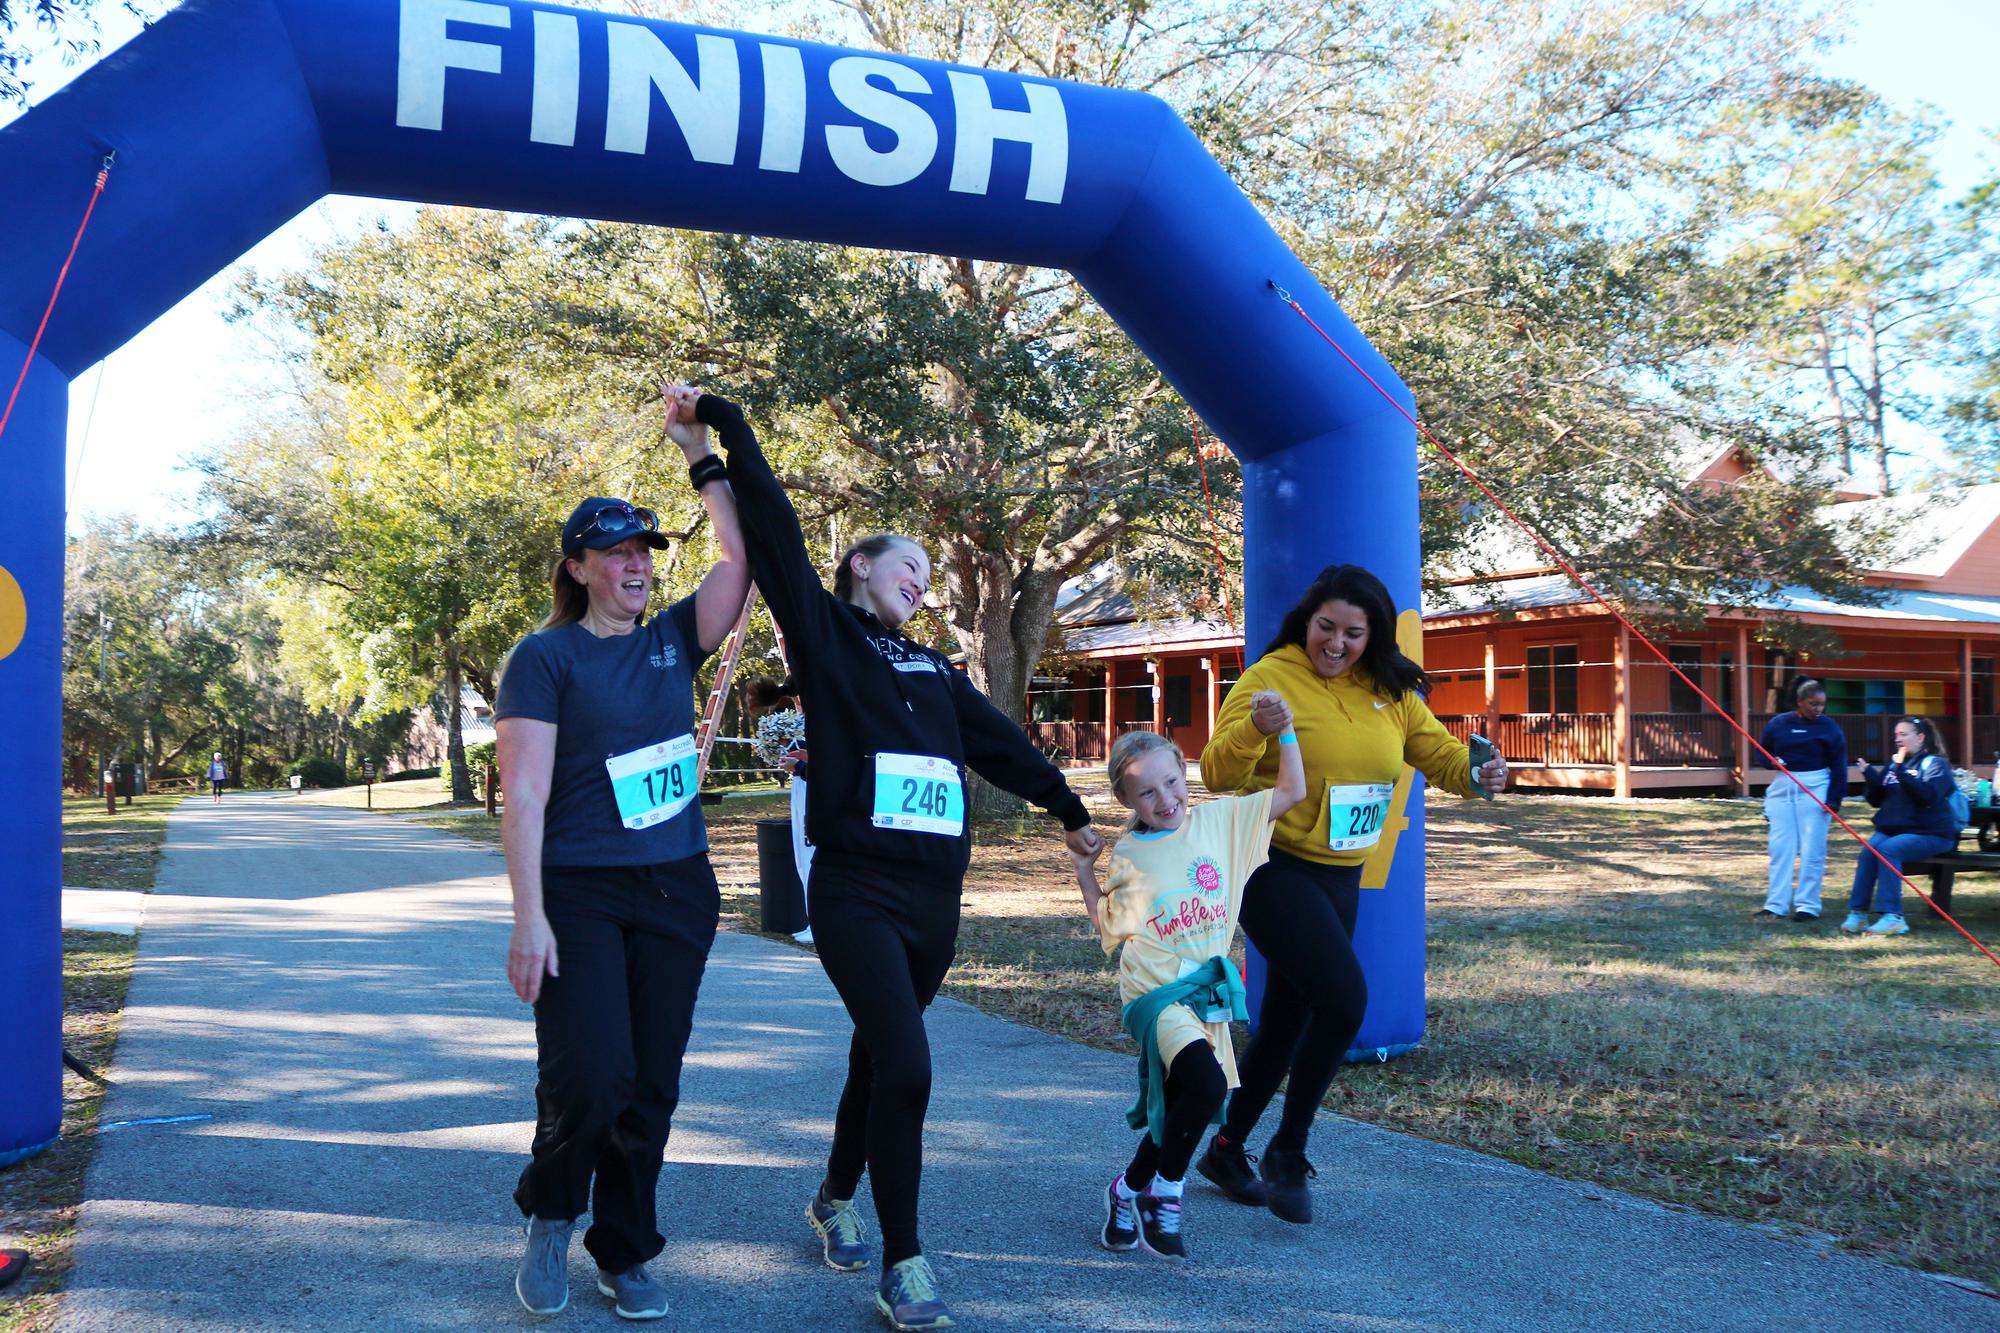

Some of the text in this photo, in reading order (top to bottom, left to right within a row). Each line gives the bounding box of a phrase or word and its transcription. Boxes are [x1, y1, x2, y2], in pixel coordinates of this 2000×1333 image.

[396, 0, 1070, 205] FINISH
[642, 763, 685, 807] 179
[901, 778, 948, 818] 246
[1349, 803, 1380, 836] 220
